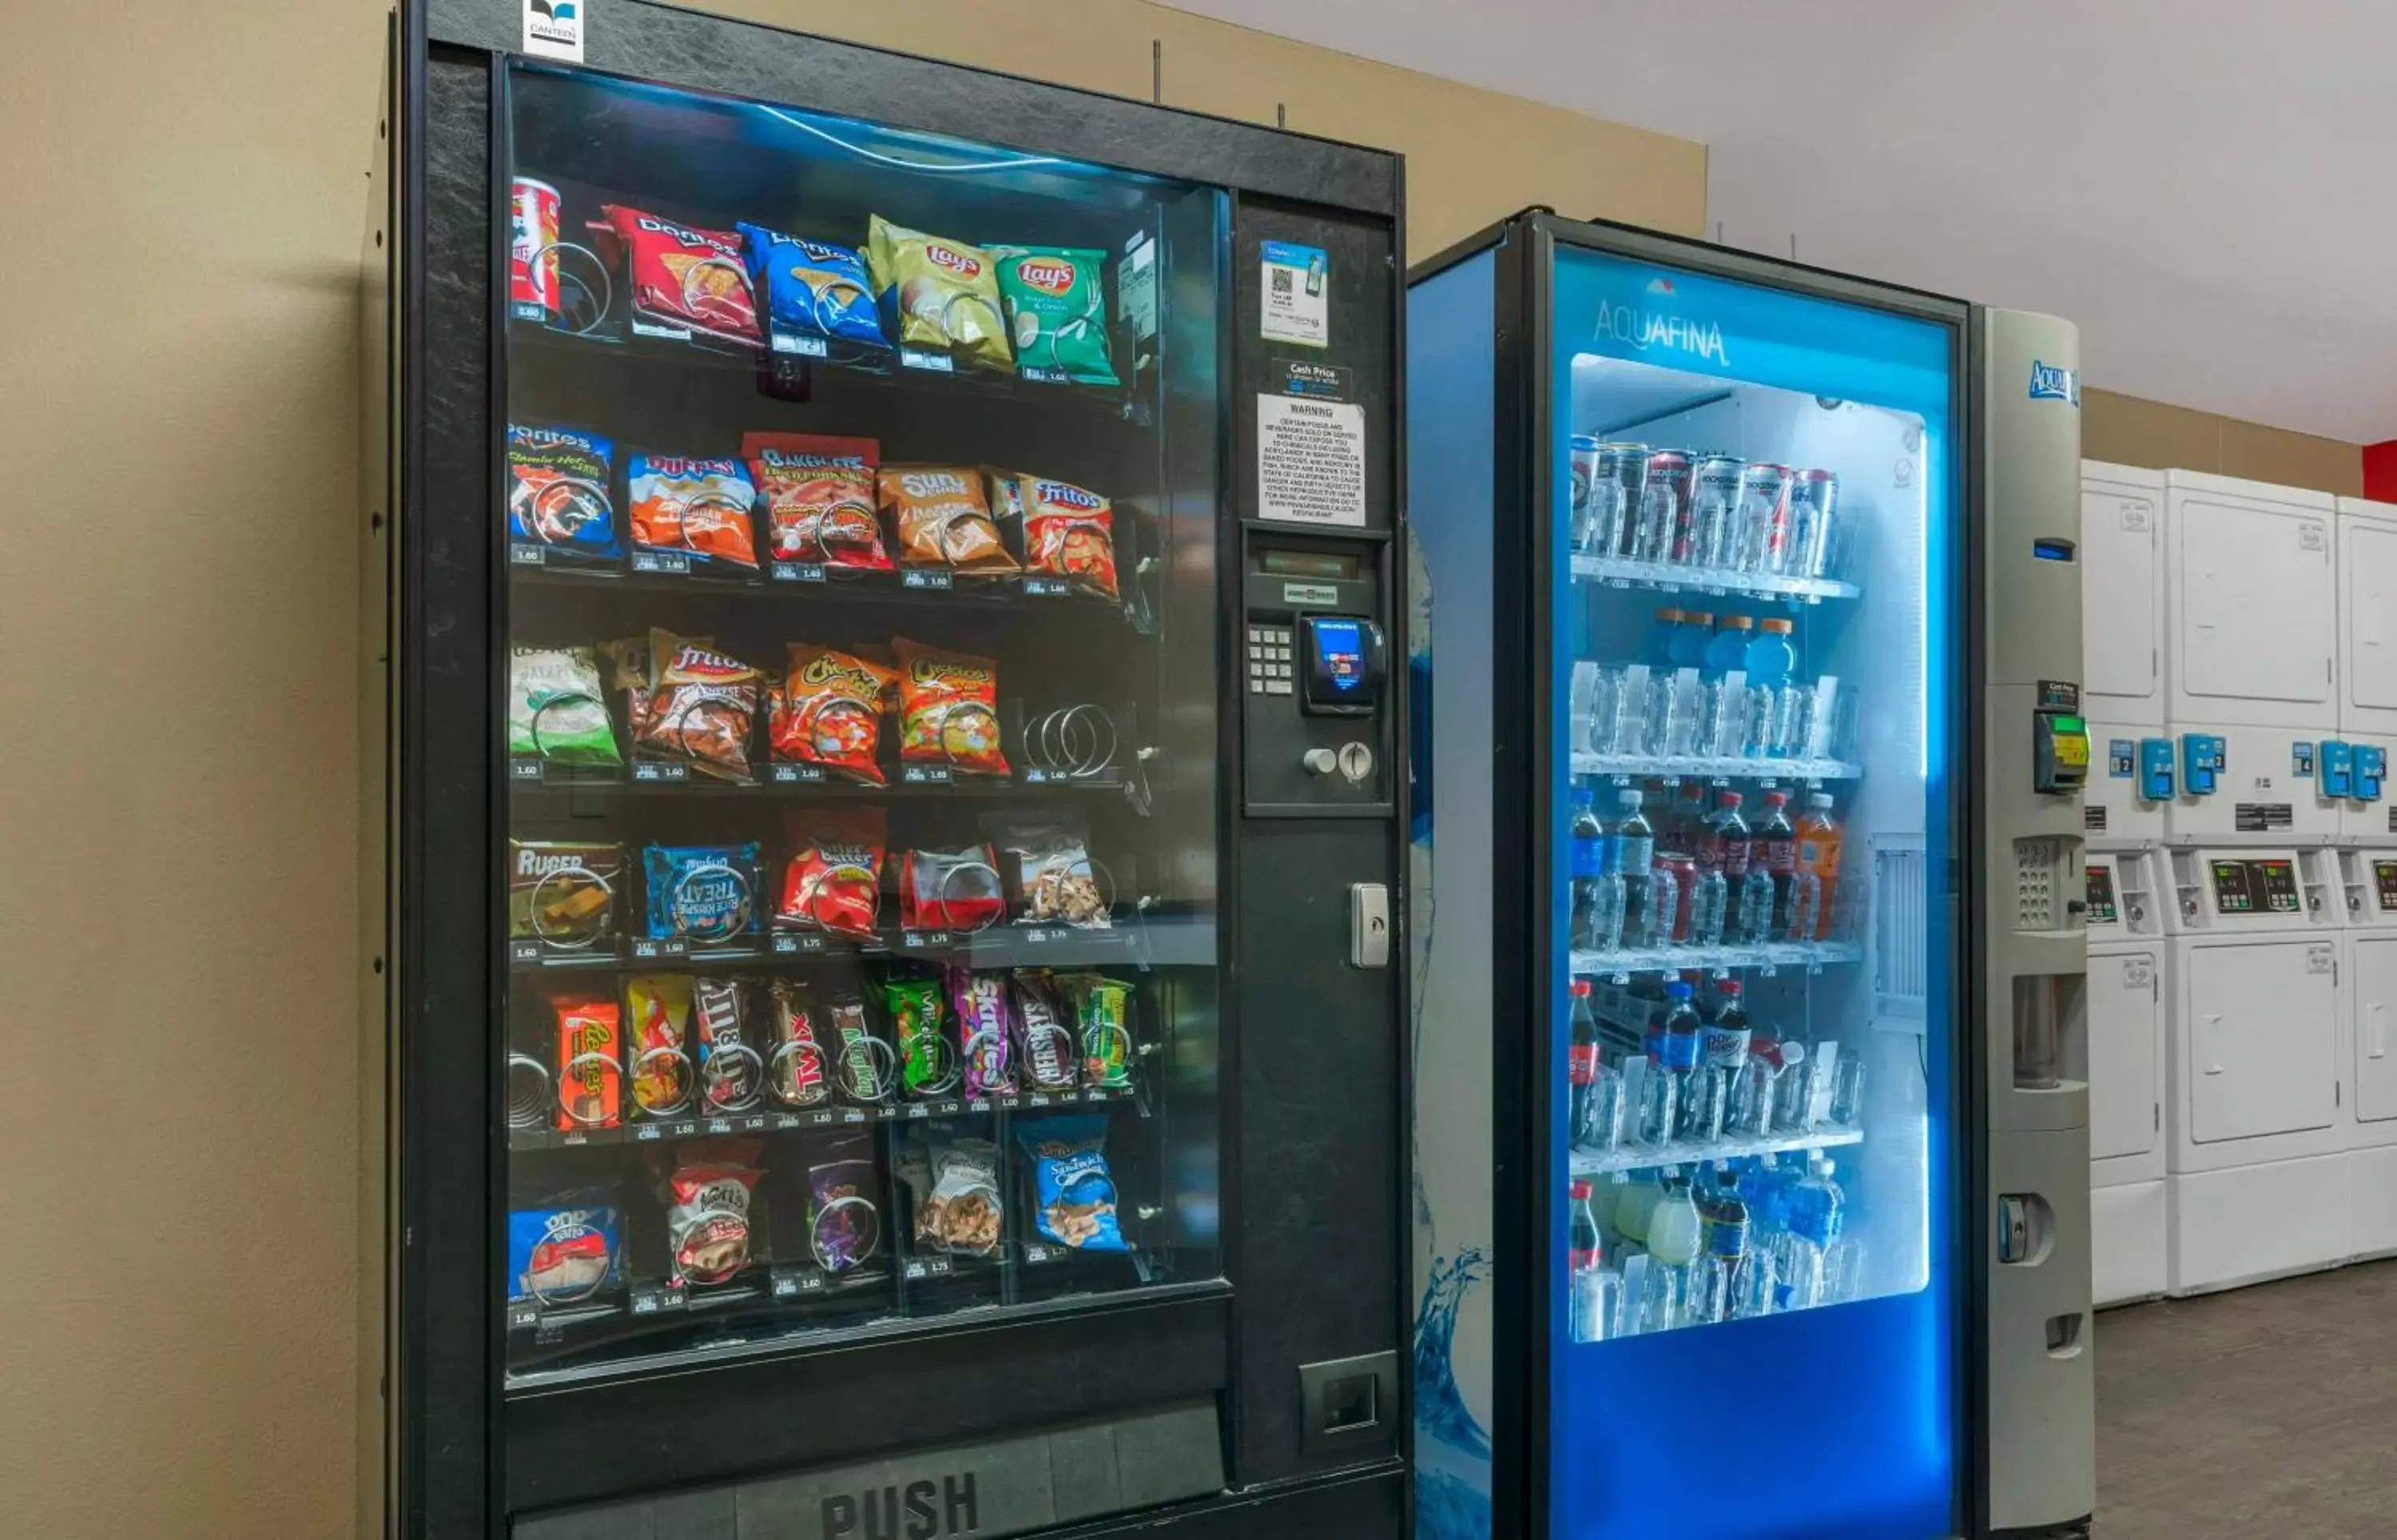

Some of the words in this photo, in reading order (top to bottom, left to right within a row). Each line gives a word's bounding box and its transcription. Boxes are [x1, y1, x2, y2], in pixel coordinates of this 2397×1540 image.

[531, 23, 575, 39] CANTEEN
[639, 217, 739, 257] Doritos
[1022, 264, 1071, 288] Lay's
[1593, 298, 1731, 367] AQUAFINA
[1290, 363, 1311, 375] Cash
[1313, 367, 1336, 378] Price
[1290, 404, 1334, 419] WARNING
[1036, 482, 1100, 510] Fritos
[519, 850, 583, 876] RUGER
[517, 948, 537, 958] 1.60
[1024, 1001, 1062, 1084] HERSHEY'S
[584, 1020, 611, 1095] Reese's
[1051, 1153, 1104, 1176] Sandwich
[821, 1471, 979, 1540] PUSH
